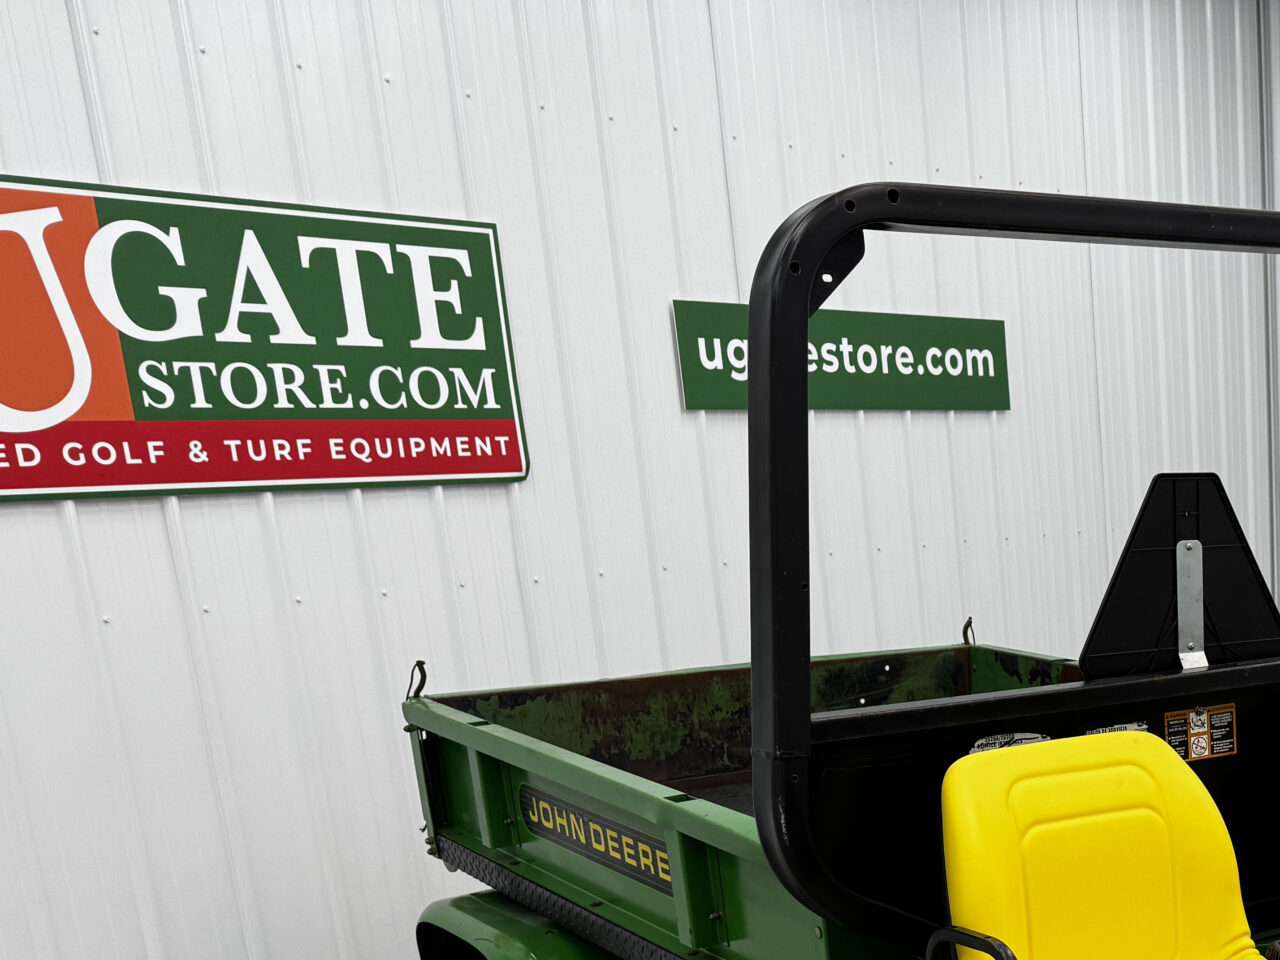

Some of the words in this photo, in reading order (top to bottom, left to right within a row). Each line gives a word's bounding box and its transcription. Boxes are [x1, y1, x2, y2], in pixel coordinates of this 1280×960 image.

[697, 337, 995, 382] ugestore.com
[138, 359, 501, 410] STORE.COM
[62, 440, 165, 466] GOLF
[188, 440, 209, 463] &
[223, 438, 313, 462] TURF
[328, 435, 510, 463] EQUIPMENT
[529, 797, 586, 845] JOHN
[589, 821, 672, 883] DEERE
